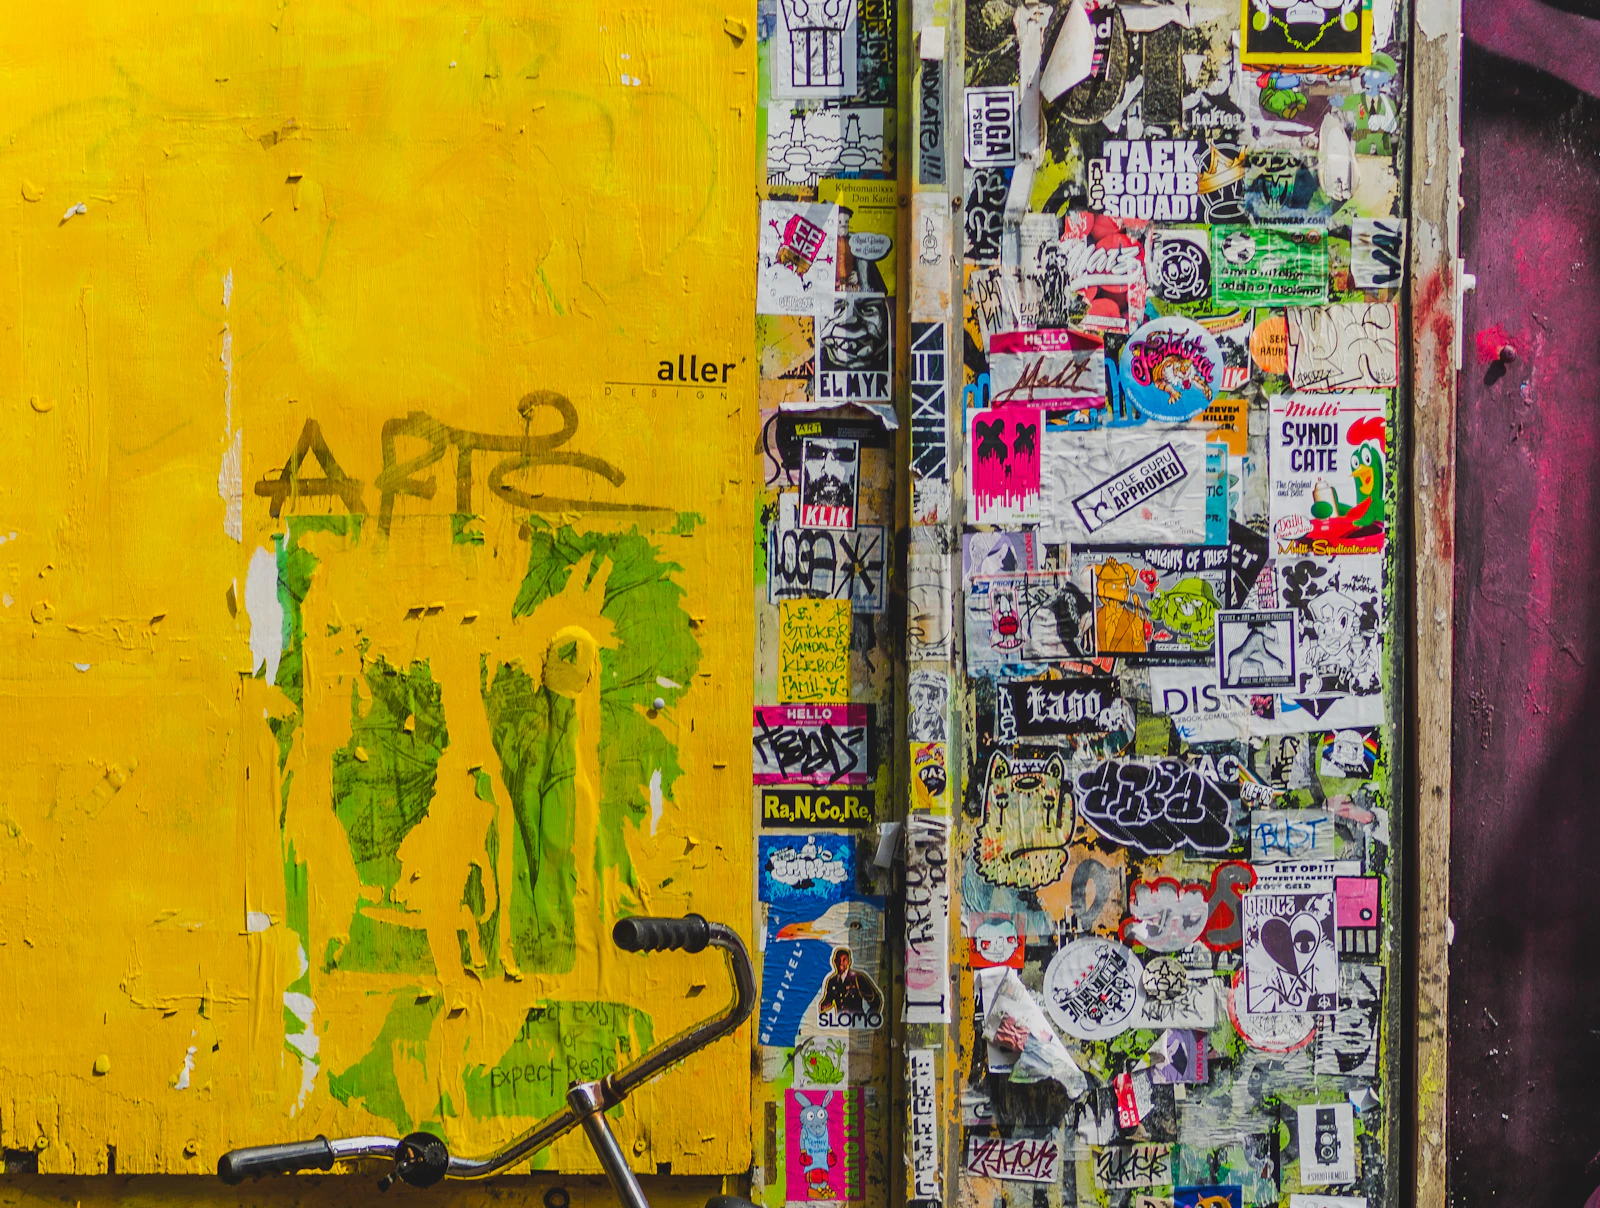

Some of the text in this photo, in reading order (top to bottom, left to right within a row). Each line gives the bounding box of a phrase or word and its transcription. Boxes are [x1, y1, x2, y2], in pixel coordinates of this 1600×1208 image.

[973, 121, 983, 146] CLUB
[985, 96, 1011, 157] LOGA
[1103, 141, 1198, 173] TAEK
[1105, 173, 1199, 195] BOMB
[852, 194, 870, 203] Don
[1103, 195, 1198, 221] SQUAD!
[1024, 333, 1069, 345] HELLO
[657, 354, 736, 383] aller
[604, 387, 728, 400] DESIGN
[820, 372, 889, 398] ELMYR
[1285, 401, 1341, 417] Multi
[1282, 421, 1339, 447] SYNDI
[1290, 448, 1338, 472] CATE
[1107, 452, 1173, 497] POLE GURU
[1112, 461, 1181, 512] APPROVED
[804, 505, 850, 528] KLIK
[1144, 549, 1228, 571] KNIGHTS OF TALES
[787, 708, 832, 719] HELLO
[1255, 817, 1329, 857] BUST
[1275, 864, 1335, 873] LET OP!!!
[1284, 882, 1311, 890] GELD
[818, 1012, 883, 1028] SLOMO
